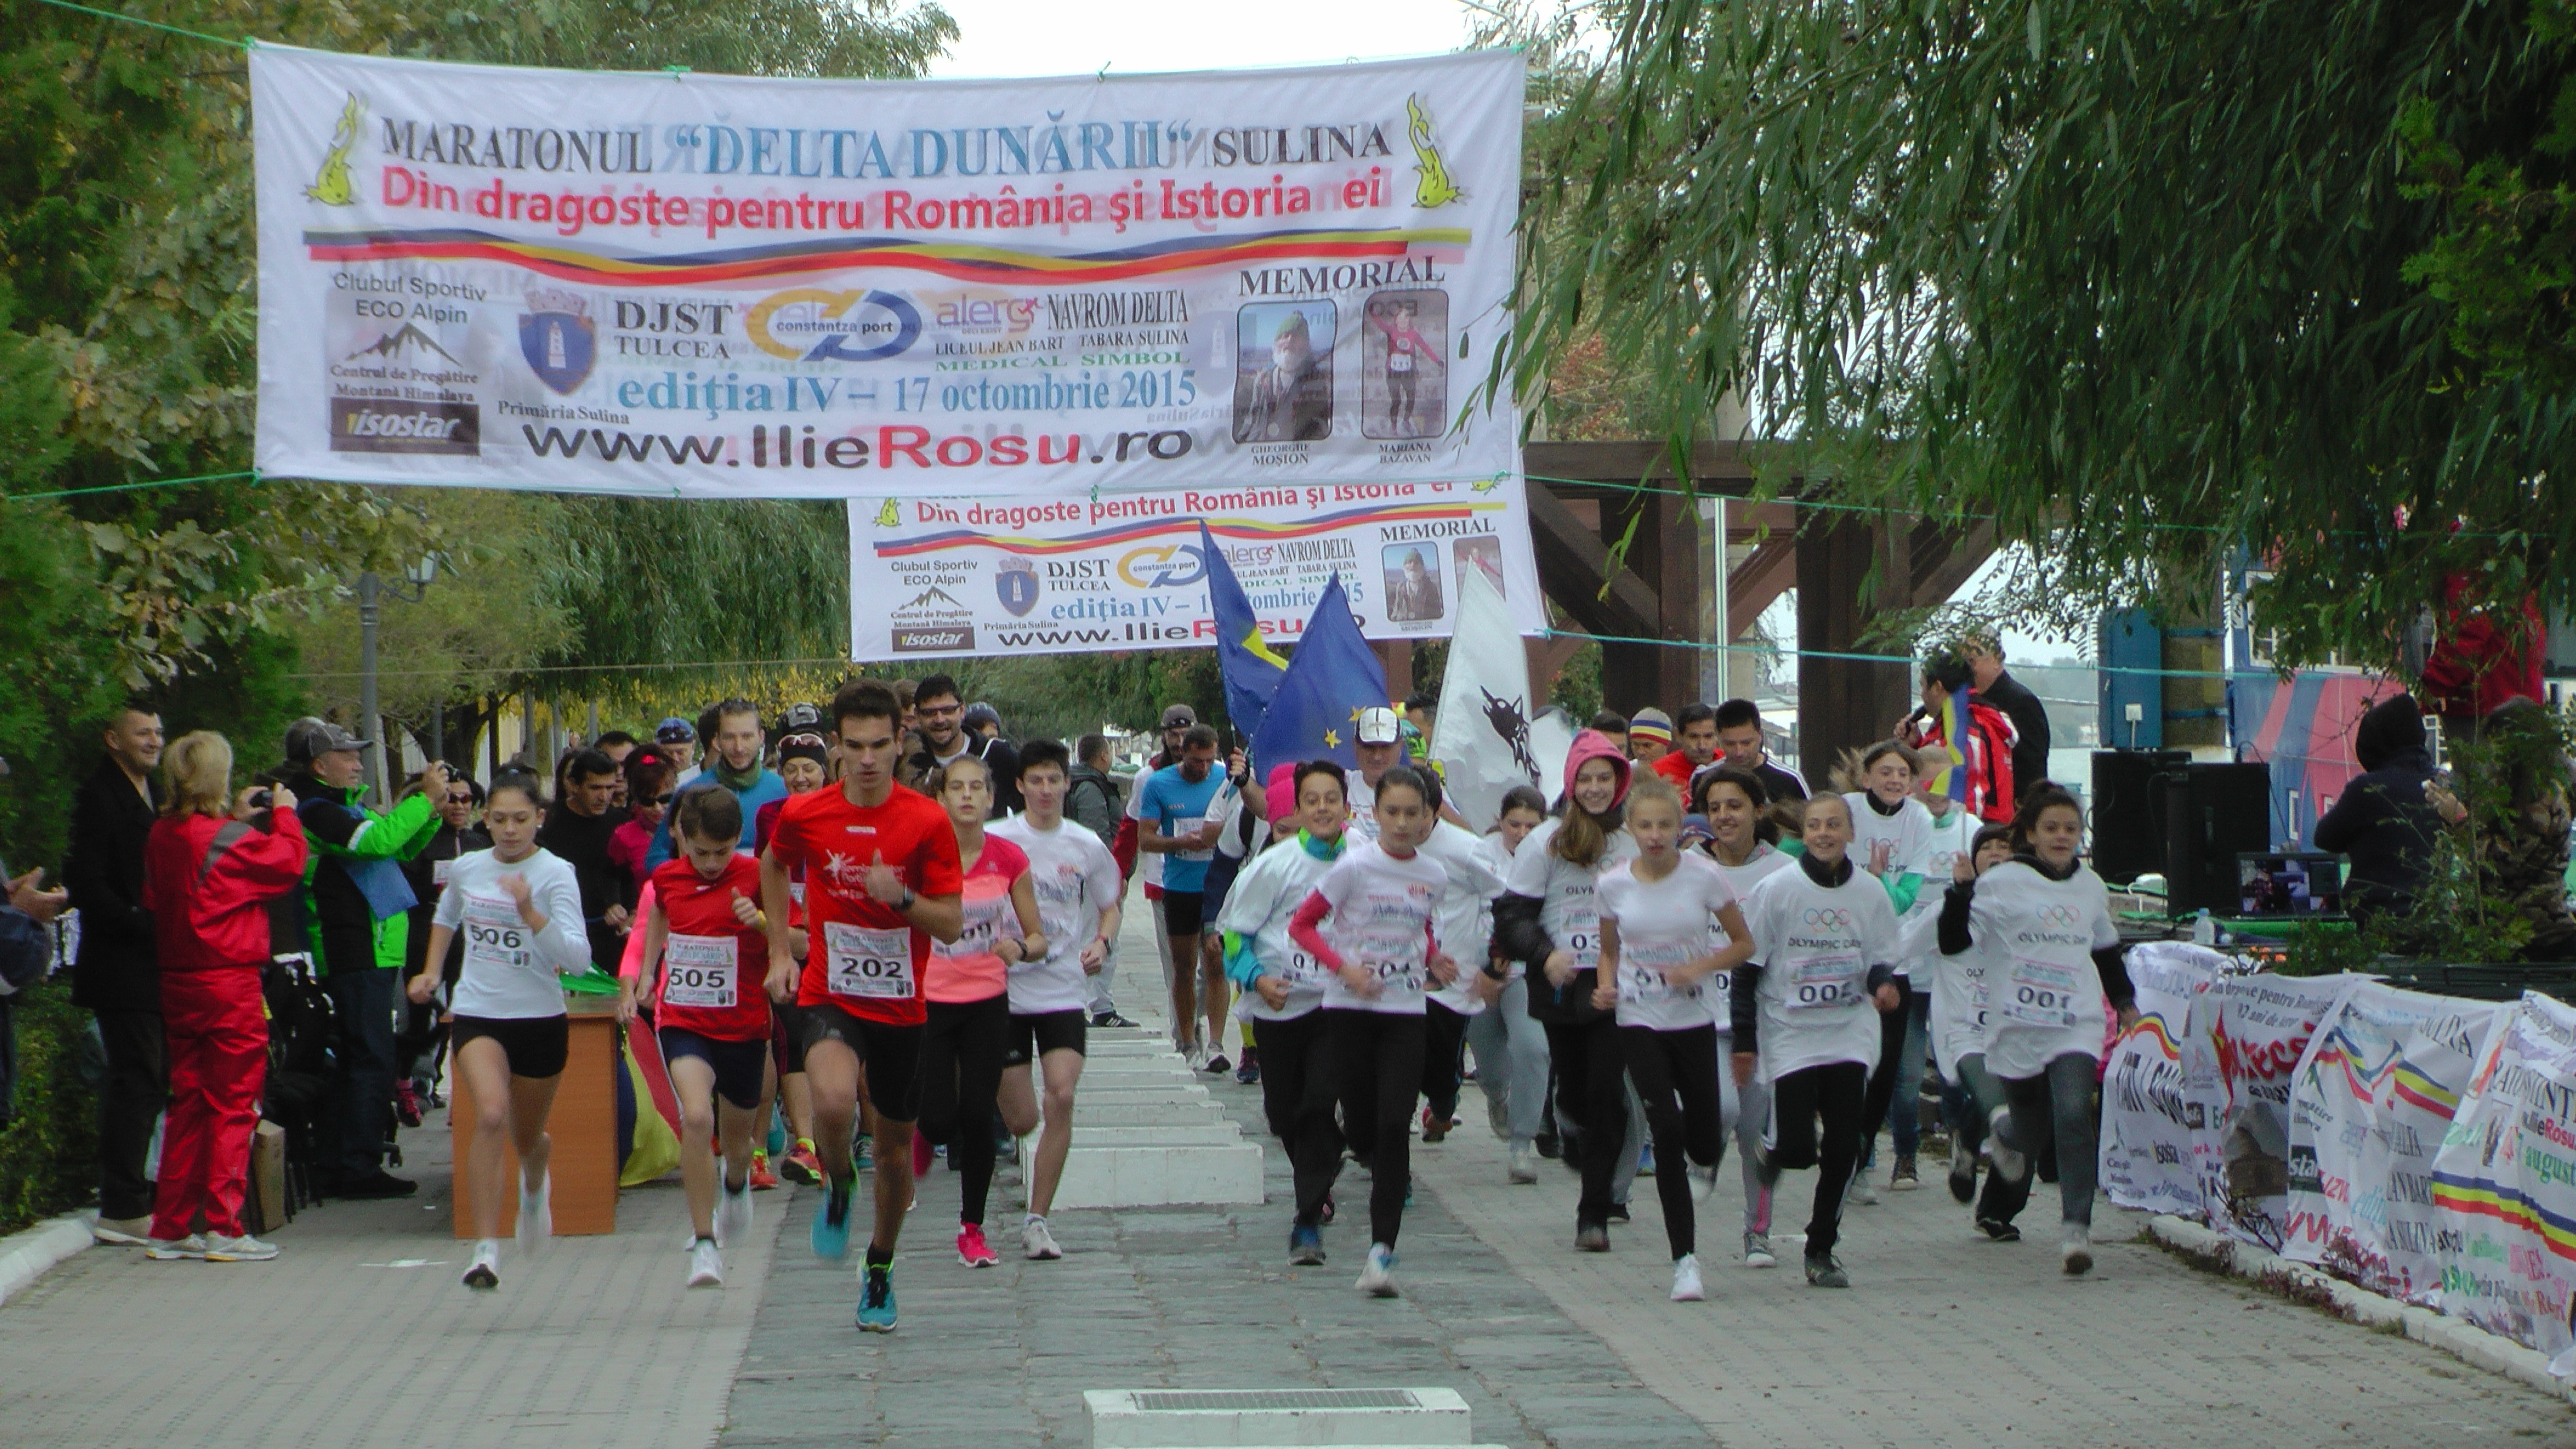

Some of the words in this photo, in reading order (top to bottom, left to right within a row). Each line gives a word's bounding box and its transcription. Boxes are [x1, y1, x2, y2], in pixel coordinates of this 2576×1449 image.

[381, 117, 652, 173] MARATONUL
[1213, 122, 1392, 168] SULINA
[381, 165, 459, 211] Din
[476, 178, 689, 235] dragoste
[706, 191, 864, 239] pentru
[884, 183, 1092, 230] România
[1160, 174, 1311, 220] Istoria
[1343, 165, 1381, 208] ei
[333, 272, 404, 293] Clubul
[409, 276, 487, 302] Sportiv
[1238, 255, 1446, 297] MEMORIAL
[355, 299, 404, 319] ECO
[412, 304, 469, 325] Alpin
[615, 299, 733, 335] DJST
[936, 293, 1042, 333] alerg
[1046, 291, 1126, 331] NAVROM
[1131, 289, 1189, 324] DELTA
[775, 319, 857, 334] constantza
[861, 319, 893, 335] port
[614, 336, 731, 360] TULCEA
[935, 341, 987, 356] LICEUL
[988, 339, 1025, 354] JEAN
[1028, 336, 1066, 352] BART
[1078, 332, 1134, 348] TABARA
[1138, 329, 1189, 346] SULINA
[935, 355, 1068, 372] MEDICAL
[1080, 351, 1191, 368] SIMBOL
[391, 367, 407, 380] de
[618, 371, 773, 421] ediţia
[786, 375, 841, 413] IV
[895, 376, 931, 413] 17
[942, 373, 1110, 412] octombrie
[1121, 369, 1196, 408] 2015
[352, 408, 461, 437] isostar
[578, 406, 630, 425] Sulina
[1379, 443, 1432, 454] MARIANA
[917, 500, 960, 524] Din
[967, 500, 1081, 530] dragoste
[1089, 494, 1176, 525] pentru
[1185, 486, 1298, 513] România
[1380, 517, 1497, 542] MEMORIAL
[1277, 540, 1321, 564] NAVROM
[1323, 538, 1356, 560] DELTA
[891, 560, 930, 572] Clubul
[933, 559, 978, 573] Sportiv
[1048, 558, 1110, 578] DJST
[1179, 561, 1196, 571] port
[1296, 564, 1327, 574] TABARA
[904, 574, 932, 585] ECO
[935, 573, 967, 586] Alpin
[1048, 580, 1111, 592] TULCEA
[1241, 578, 1292, 588] DICAL
[1299, 573, 1358, 584] SIMOL
[1142, 596, 1171, 615] IV
[1028, 620, 1058, 629] Sulina
[1566, 885, 1595, 895] OLYM
[470, 924, 522, 949] 506
[670, 968, 726, 988] 505
[840, 957, 904, 979] 202
[2017, 986, 2071, 1009] 001
